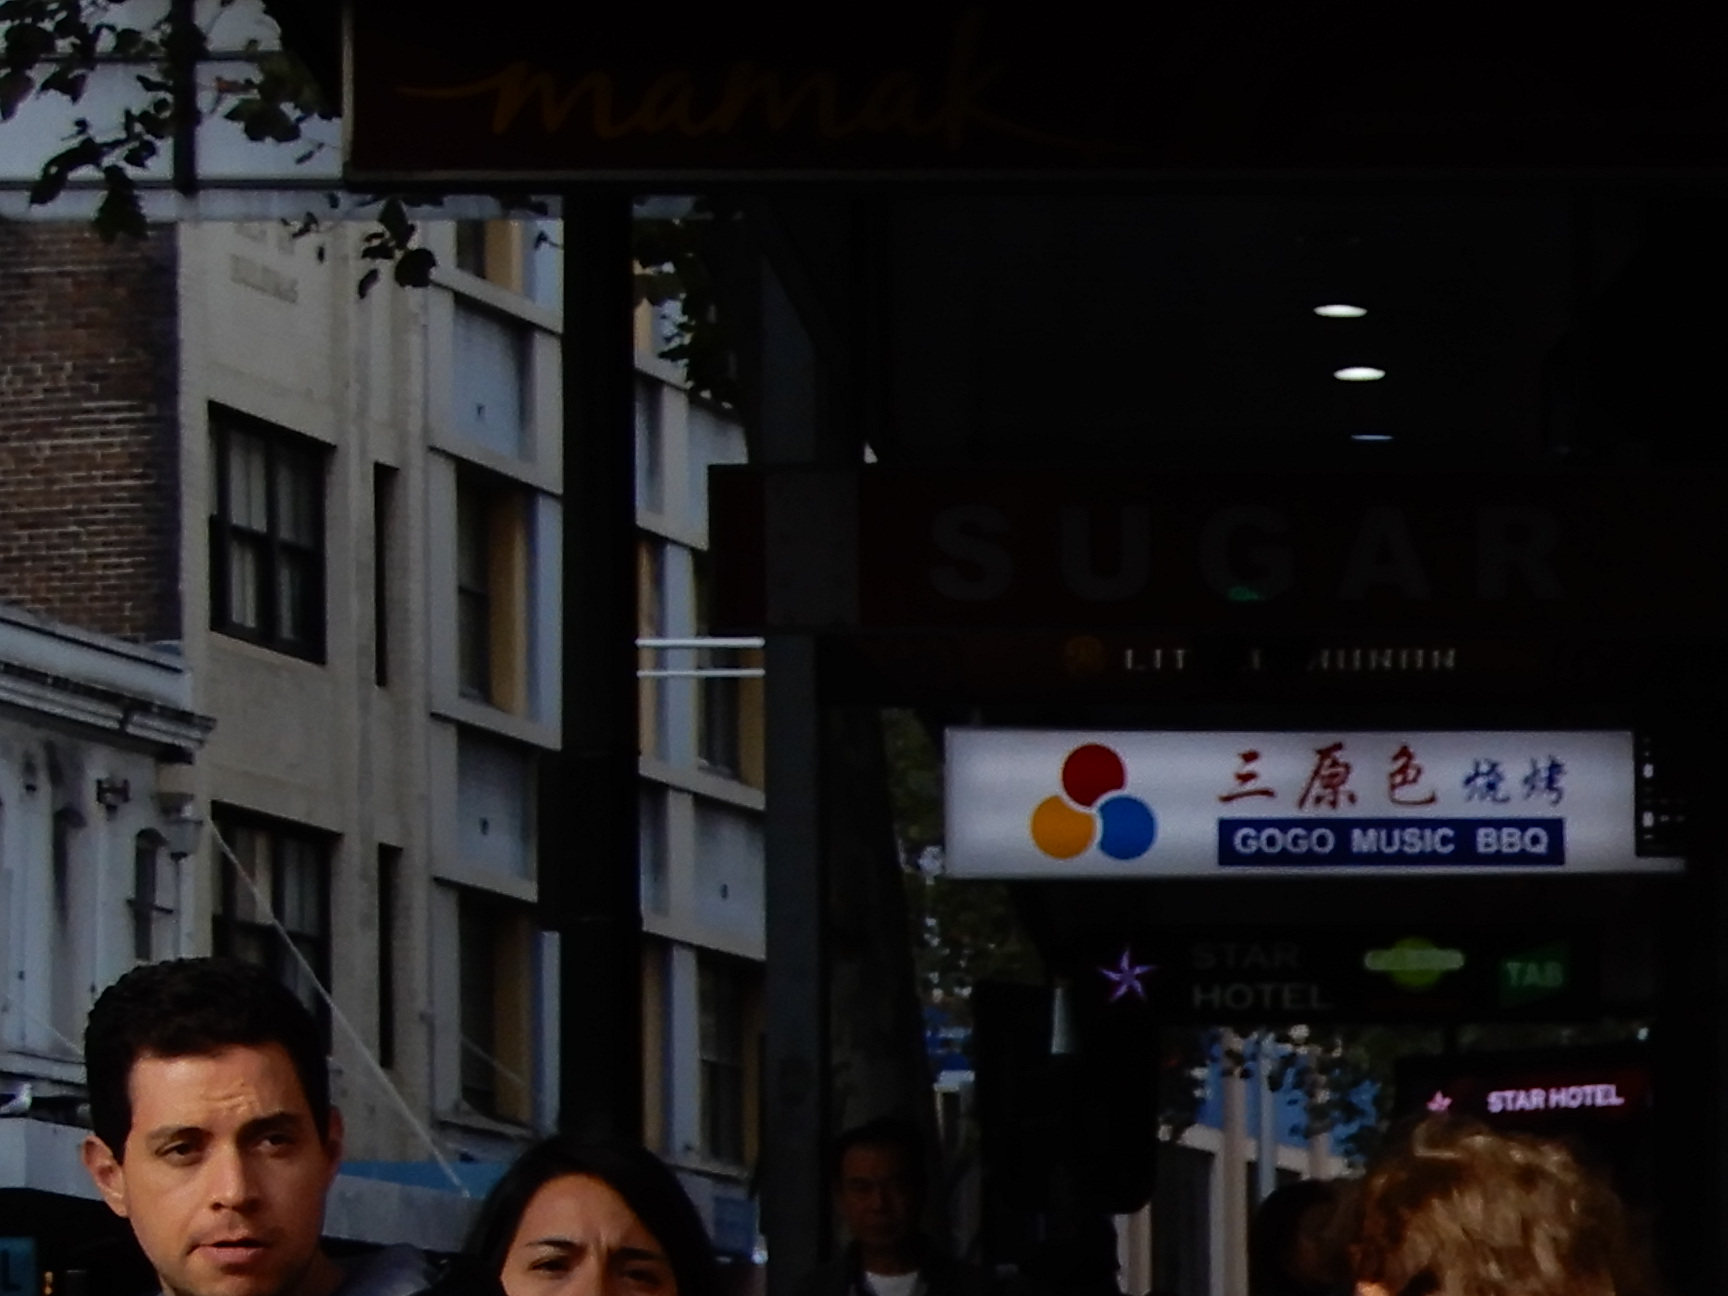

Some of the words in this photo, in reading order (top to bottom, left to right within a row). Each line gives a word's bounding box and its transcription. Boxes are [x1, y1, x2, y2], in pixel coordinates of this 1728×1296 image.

[394, 4, 1150, 160] mamak
[928, 501, 1567, 605] SUGAR
[1233, 827, 1336, 855] GOGO
[1351, 827, 1456, 855] MUSIC
[1476, 827, 1549, 855] BBQ
[1190, 939, 1300, 971] STAR
[1506, 961, 1564, 988] TAB
[1192, 982, 1336, 1011] HOTEL
[1486, 1087, 1547, 1114] STAR
[1549, 1083, 1625, 1109] HOTEL
